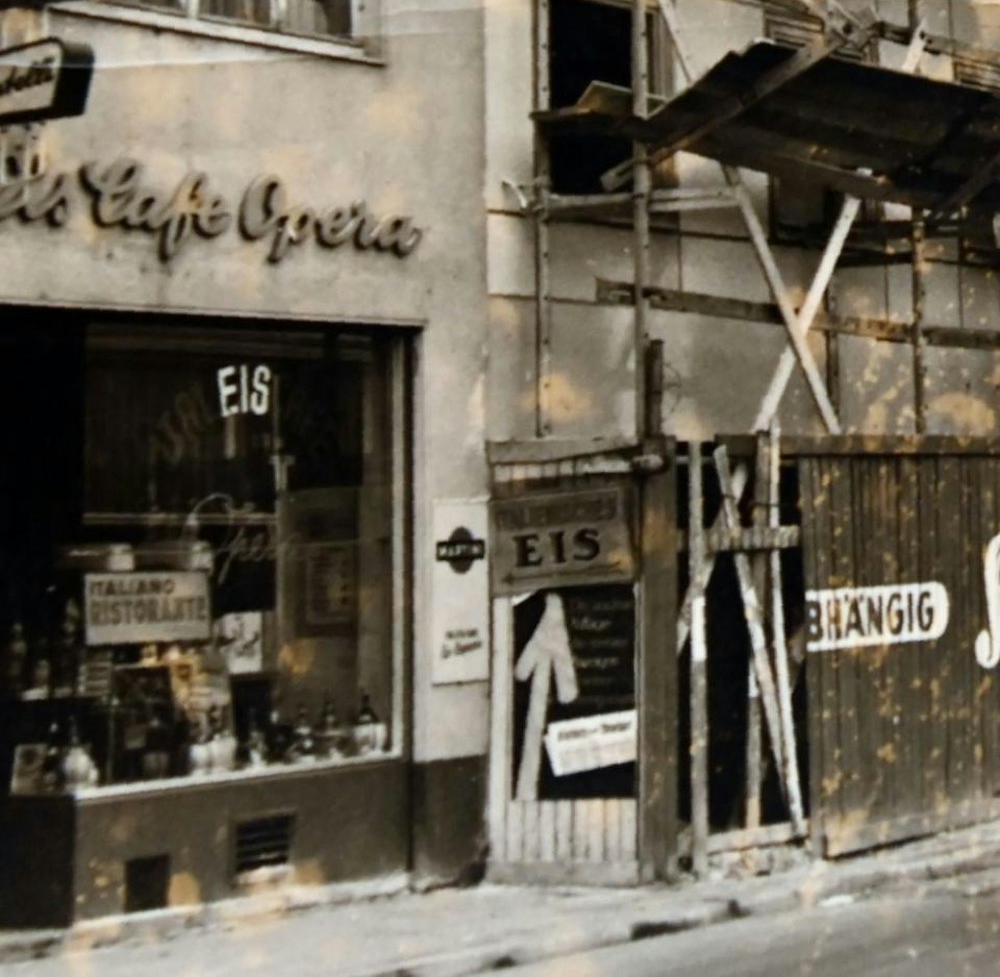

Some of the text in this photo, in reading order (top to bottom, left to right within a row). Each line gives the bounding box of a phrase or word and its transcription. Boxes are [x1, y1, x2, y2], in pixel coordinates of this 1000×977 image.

[239, 172, 423, 264] Opera
[217, 365, 271, 417] EIS
[512, 527, 601, 568] EIS
